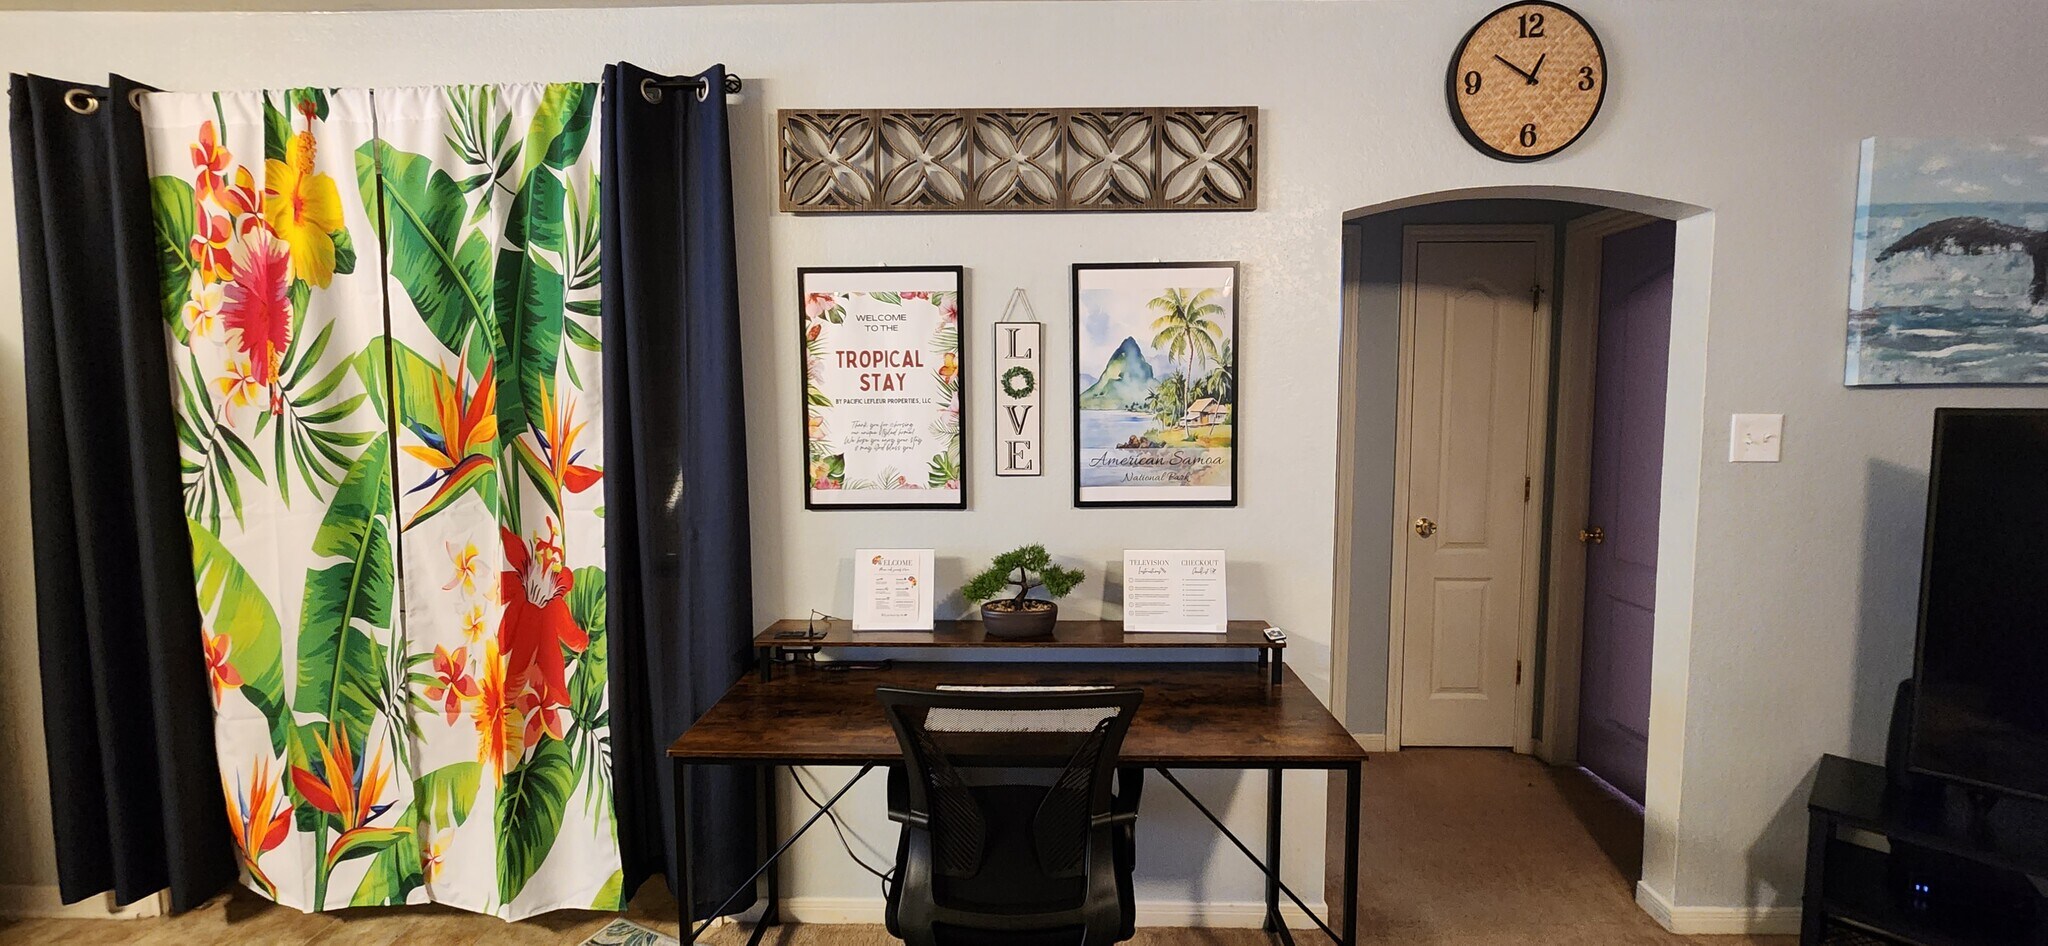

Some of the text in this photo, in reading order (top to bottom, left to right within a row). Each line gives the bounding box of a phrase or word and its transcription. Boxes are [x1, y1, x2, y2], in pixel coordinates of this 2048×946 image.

[1517, 13, 1546, 39] 12
[1464, 71, 1482, 95] 9
[1577, 66, 1595, 91] 3
[1519, 123, 1537, 147] 6
[856, 314, 907, 322] WELCOME
[864, 324, 899, 332] TO THE
[835, 350, 924, 368] TROPICAL
[860, 373, 907, 392] STAY
[851, 420, 867, 429] Thank
[1089, 451, 1224, 467] American Samoa
[1121, 472, 1192, 483] National Park
